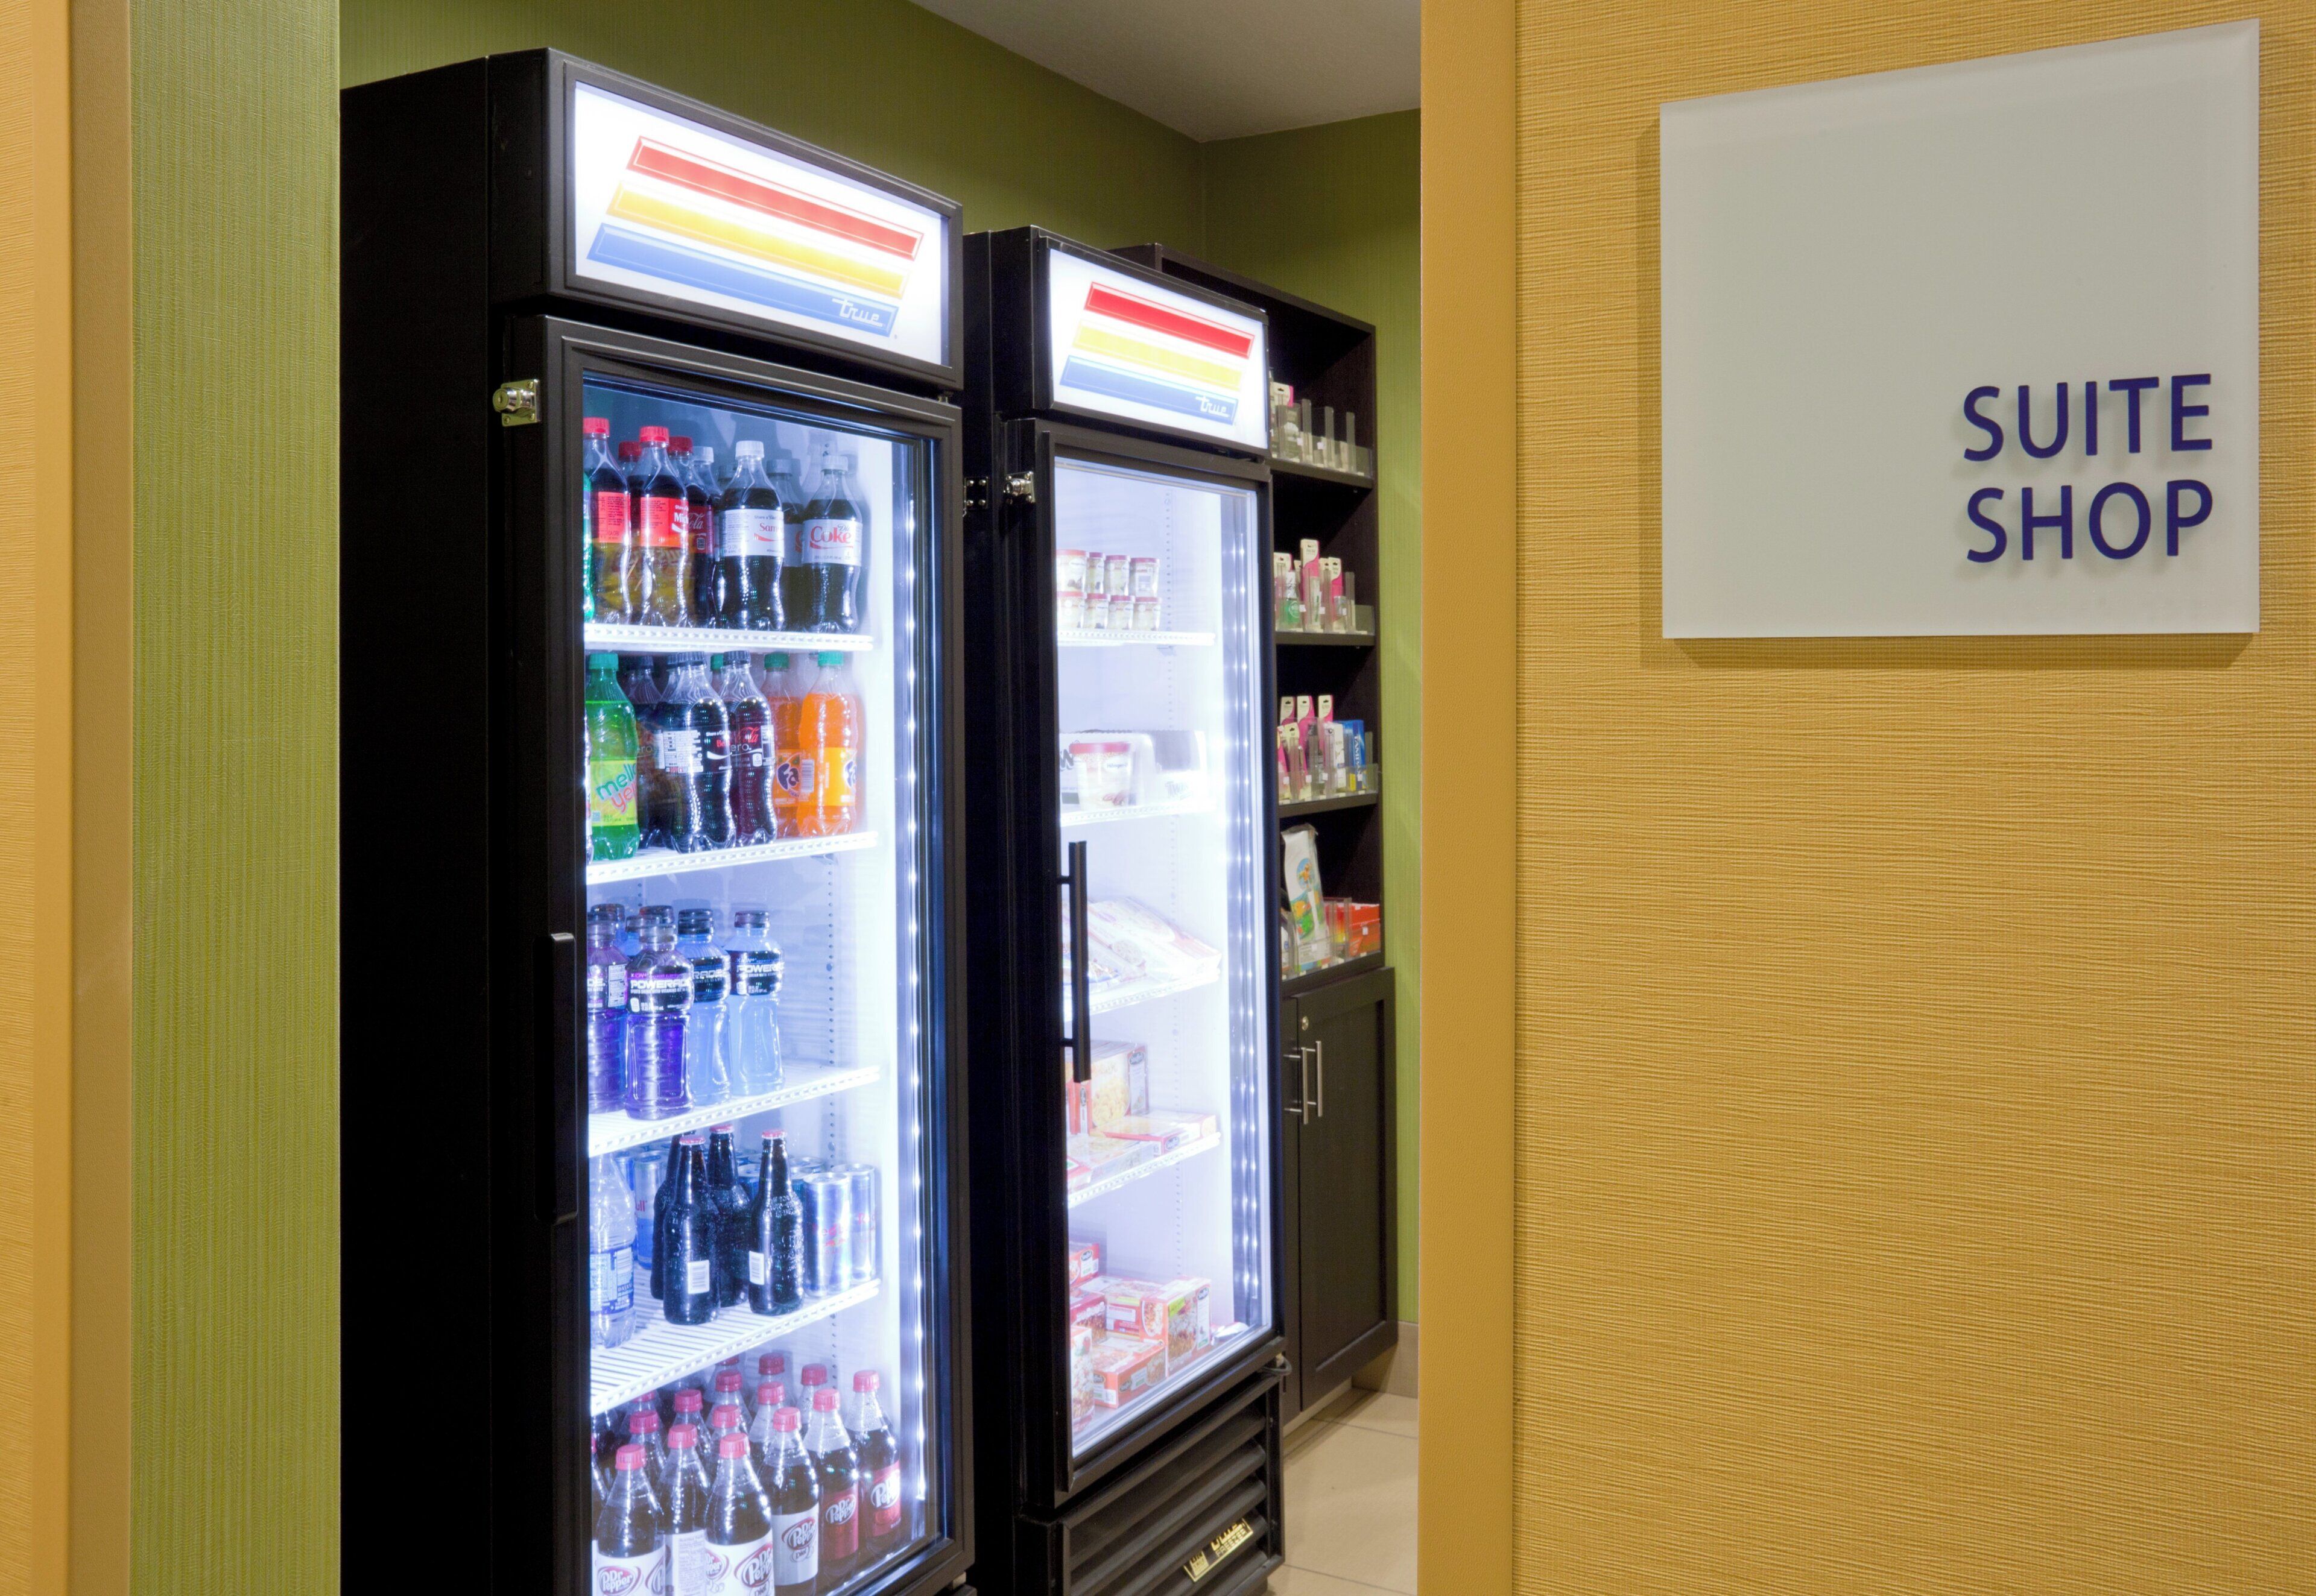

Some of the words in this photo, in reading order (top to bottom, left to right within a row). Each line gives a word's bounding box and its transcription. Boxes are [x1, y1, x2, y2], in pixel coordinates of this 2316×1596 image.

[832, 298, 883, 327] true
[1195, 396, 1229, 417] true
[1964, 373, 2212, 461] SUITE
[1967, 479, 2212, 563] SHOP
[810, 526, 852, 544] Coke
[602, 1571, 632, 1593] Pepper
